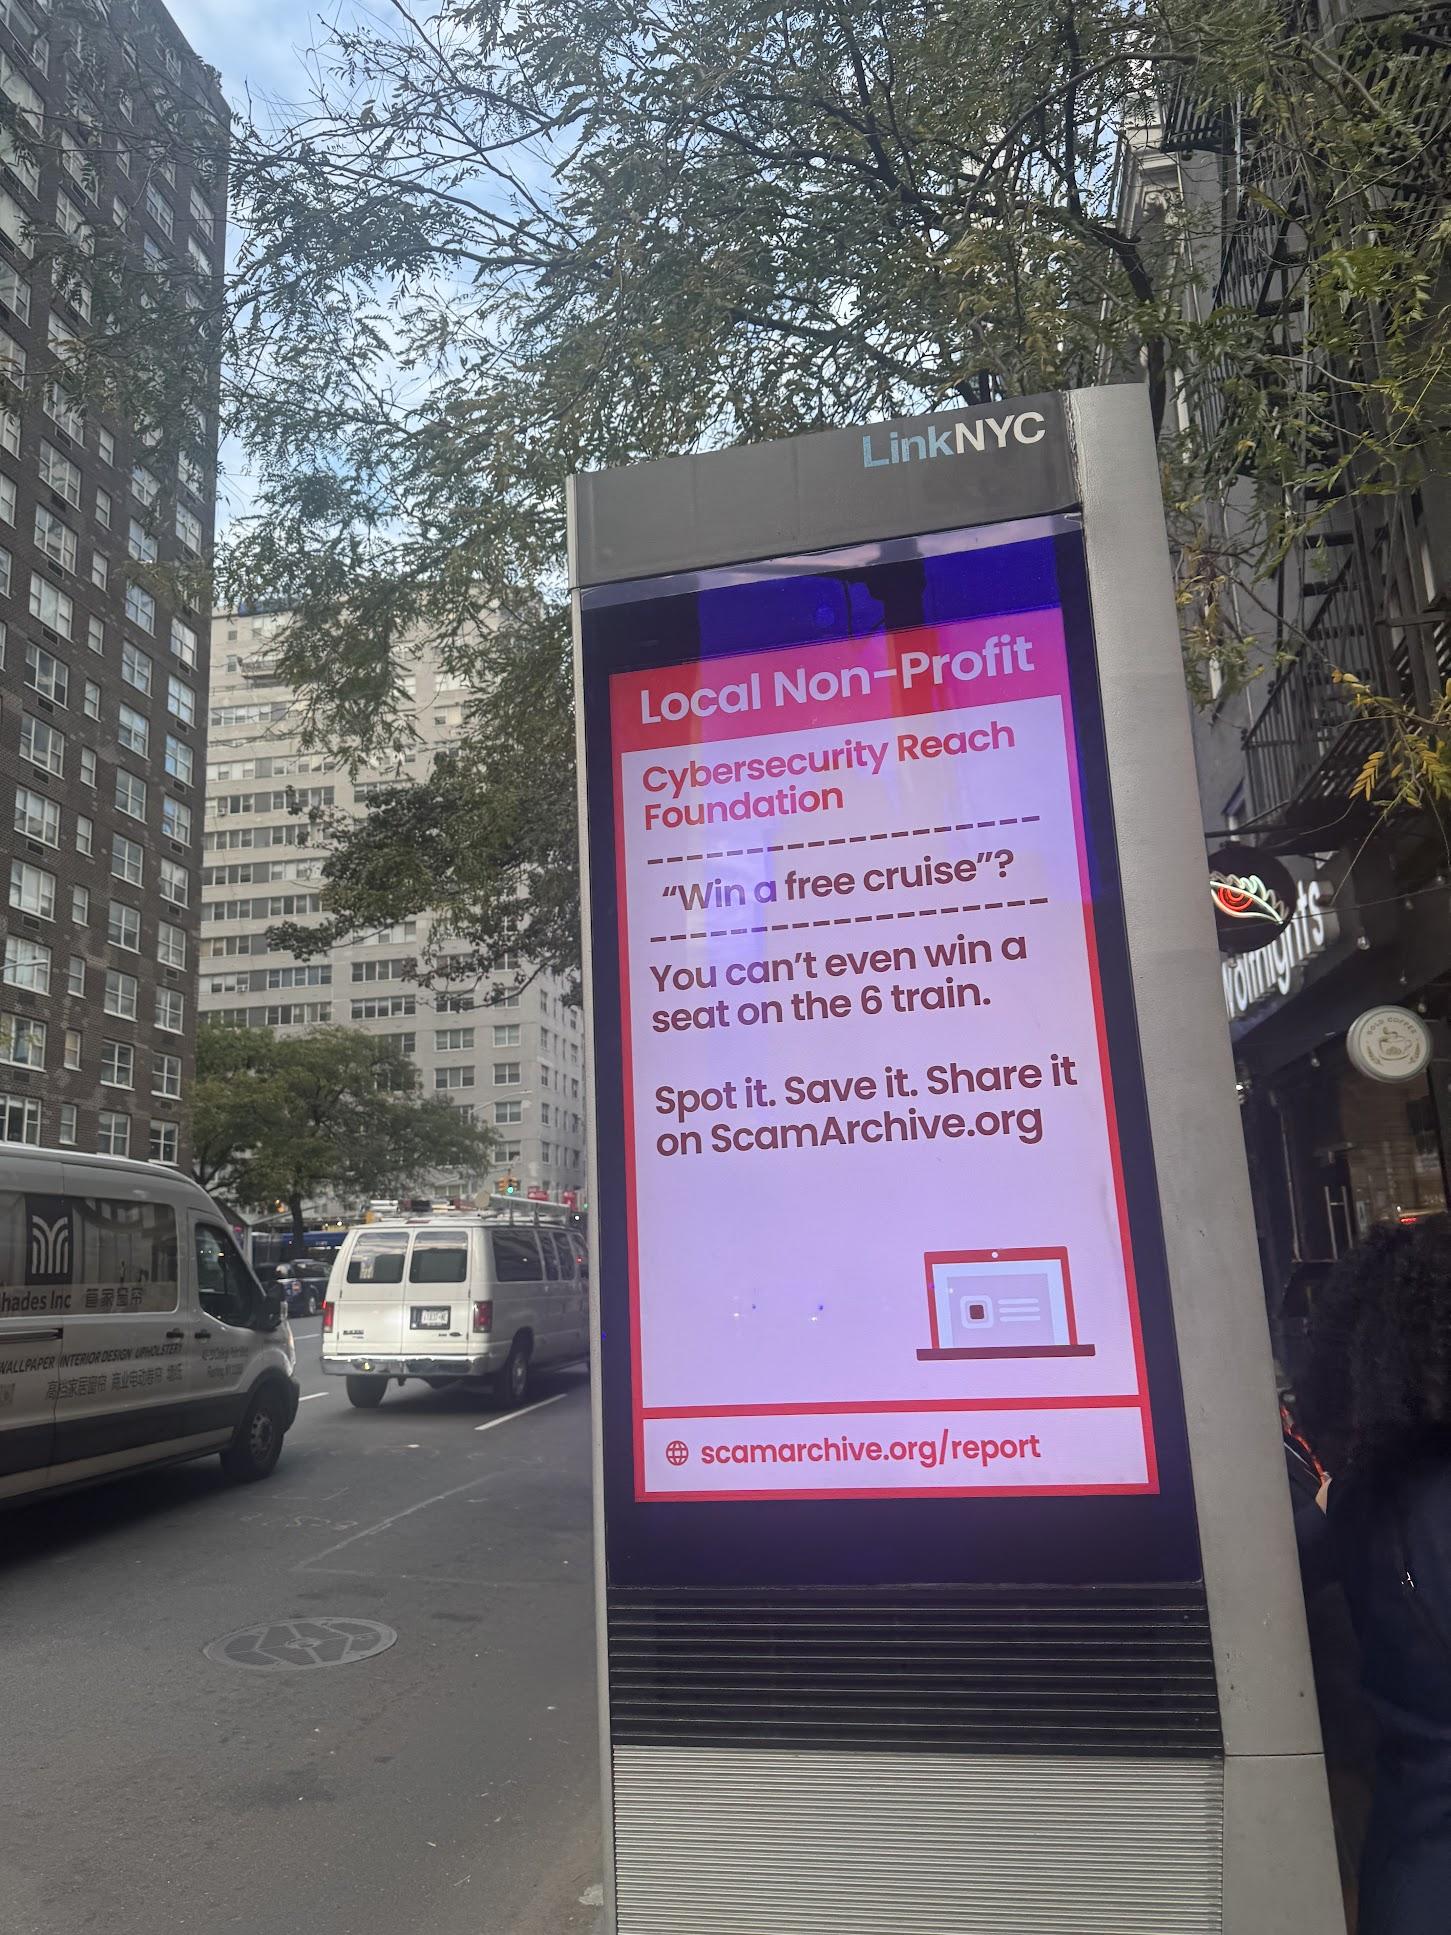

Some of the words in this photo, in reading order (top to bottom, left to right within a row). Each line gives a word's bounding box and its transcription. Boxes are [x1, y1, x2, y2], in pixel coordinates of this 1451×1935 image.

[863, 412, 1045, 467] LinkNYC
[641, 673, 761, 724] Local
[774, 635, 1034, 706] Non-Profit
[643, 739, 888, 798] Cybersecurity
[898, 721, 1015, 761] Reach
[645, 785, 843, 830] Foundation
[754, 881, 777, 903] a
[785, 871, 855, 900] free
[649, 965, 716, 992] You
[726, 952, 817, 985] can’t
[826, 948, 916, 976] even
[924, 934, 992, 967] win
[1002, 937, 1027, 960] a
[653, 1001, 730, 1032] seat
[738, 1001, 783, 1025] on
[791, 991, 851, 1020] the
[861, 986, 882, 1014] 6
[891, 977, 990, 1012] train.
[656, 1082, 737, 1122] Spot
[745, 1077, 776, 1107] it.
[785, 1077, 876, 1104] Save
[885, 1066, 917, 1097] it.
[927, 1063, 1042, 1094] Share
[1051, 1054, 1077, 1086] it
[657, 1132, 702, 1156] on
[712, 1108, 1042, 1152] ScamArchive.org
[0, 1291, 47, 1312] hades
[50, 1290, 72, 1310] Inc
[0, 1356, 55, 1374] WALLPAPER
[60, 1351, 101, 1368] INTERIOR
[101, 1348, 132, 1363] DESIGN
[135, 1343, 183, 1359] UPHOLSTERY
[702, 1428, 1041, 1467] scamarchive.org/report
